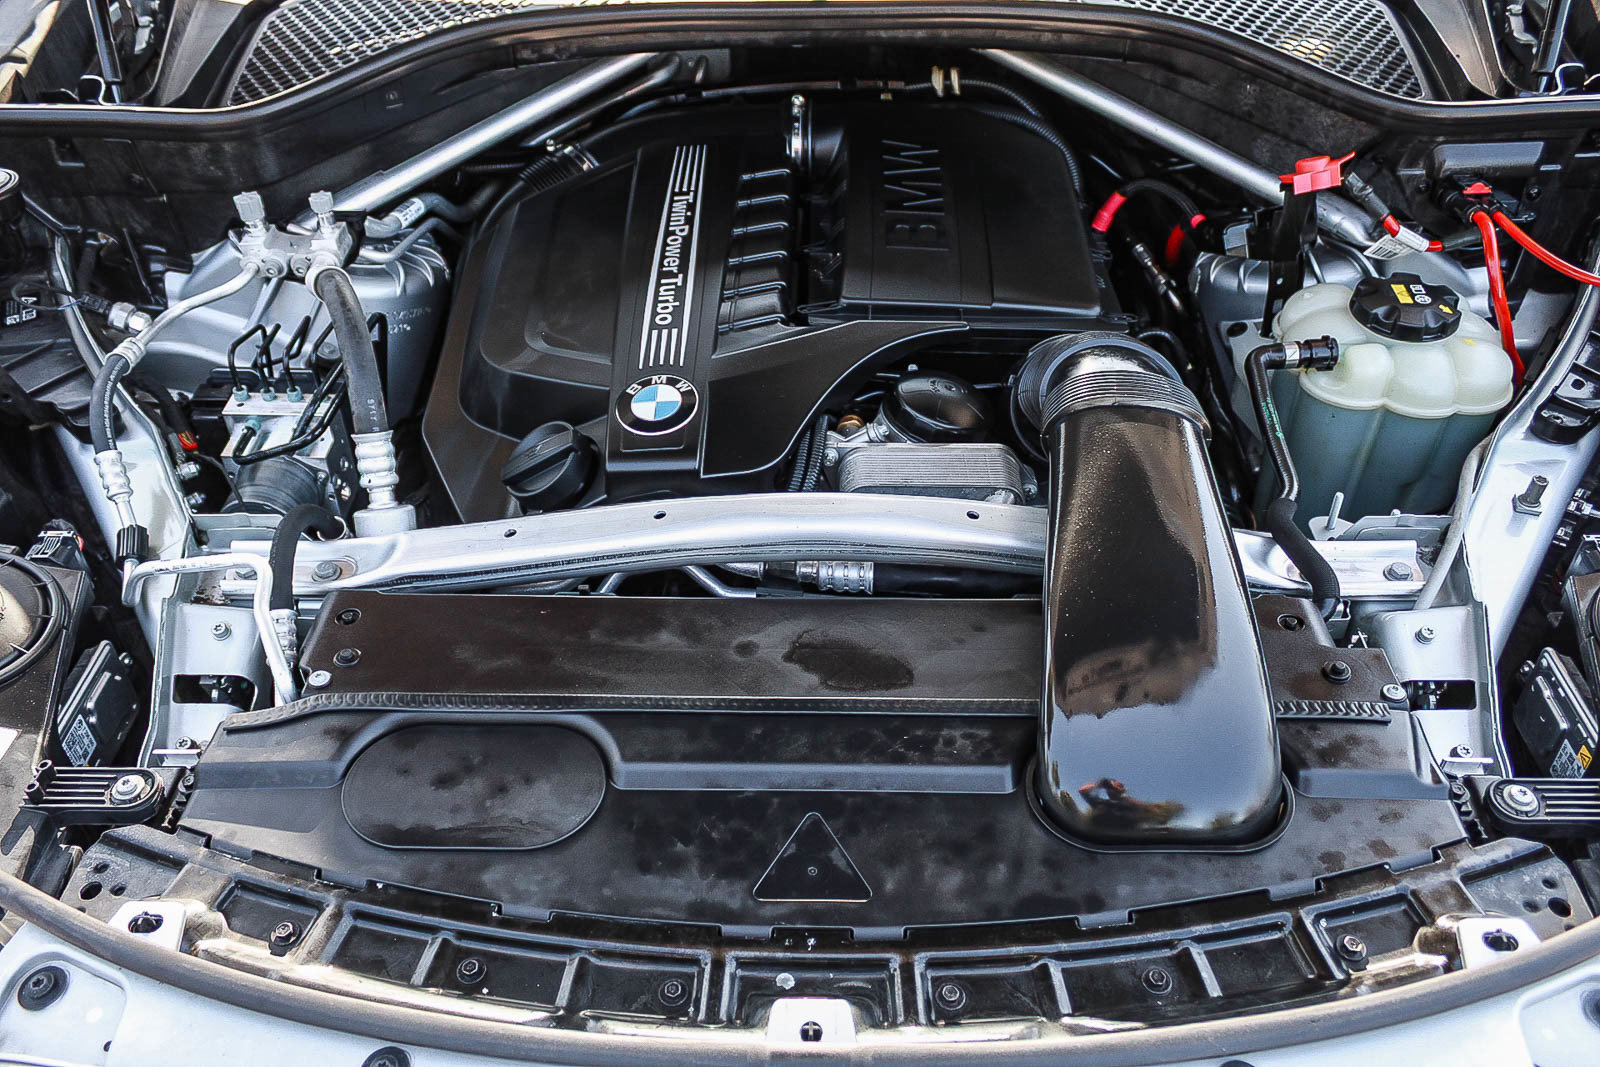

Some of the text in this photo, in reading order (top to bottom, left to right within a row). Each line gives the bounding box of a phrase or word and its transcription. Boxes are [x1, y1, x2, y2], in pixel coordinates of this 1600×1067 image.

[881, 139, 950, 251] BMW
[654, 191, 694, 326] TwinPower Turbo
[625, 374, 692, 396] BMW
